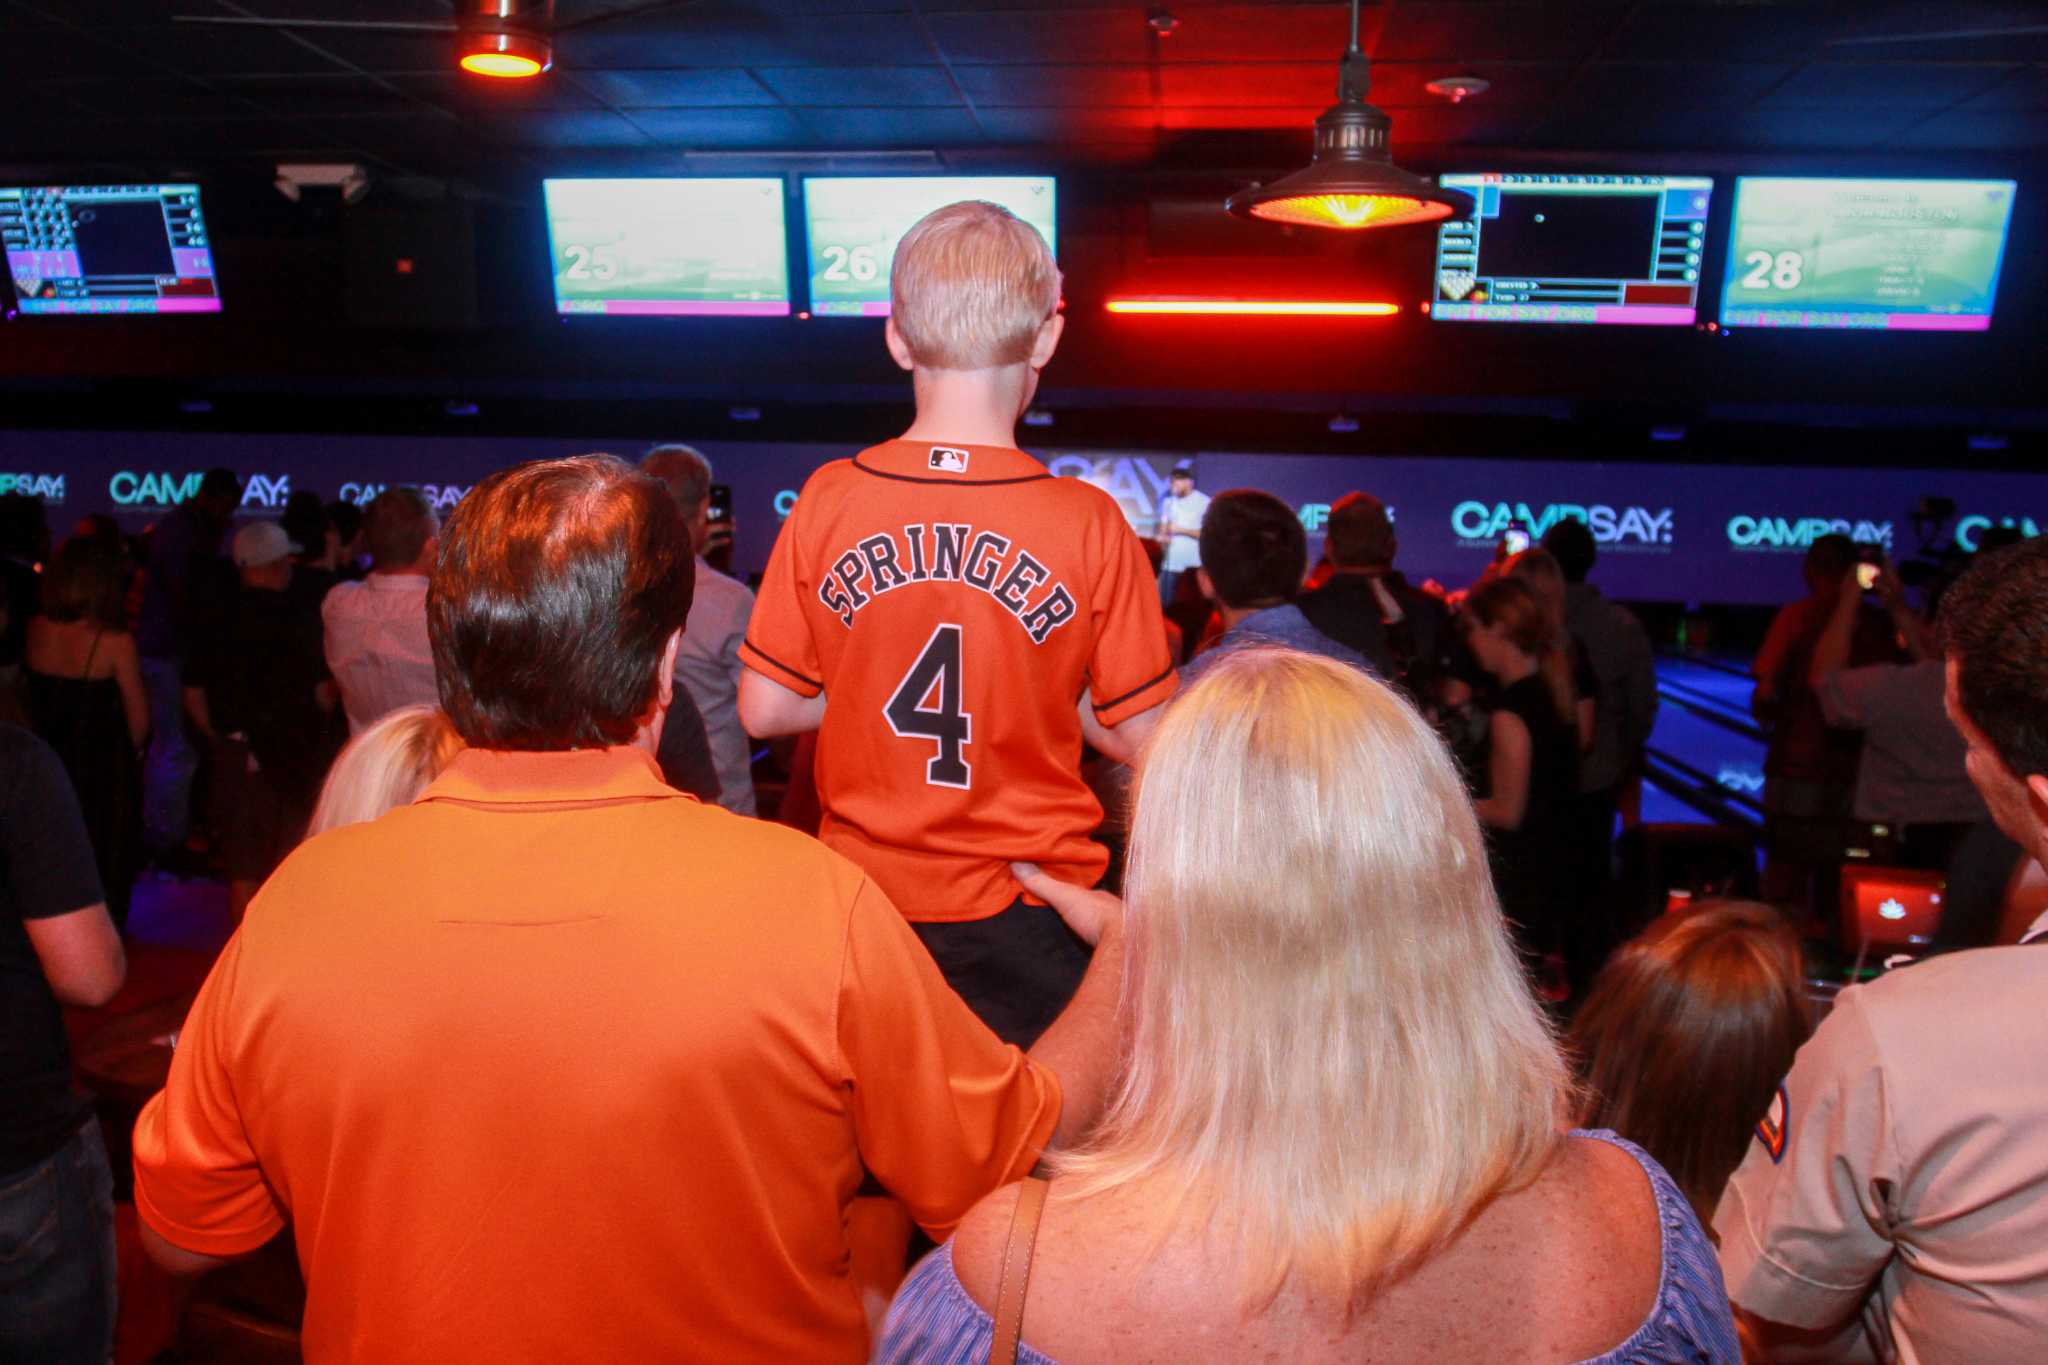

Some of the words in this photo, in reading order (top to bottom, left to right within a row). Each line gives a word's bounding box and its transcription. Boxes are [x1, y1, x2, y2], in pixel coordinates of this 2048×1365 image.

[564, 245, 618, 281] 25
[822, 245, 878, 281] 26
[1742, 250, 1804, 290] 28
[818, 523, 1077, 645] SPRINGER
[883, 622, 972, 790] 4
